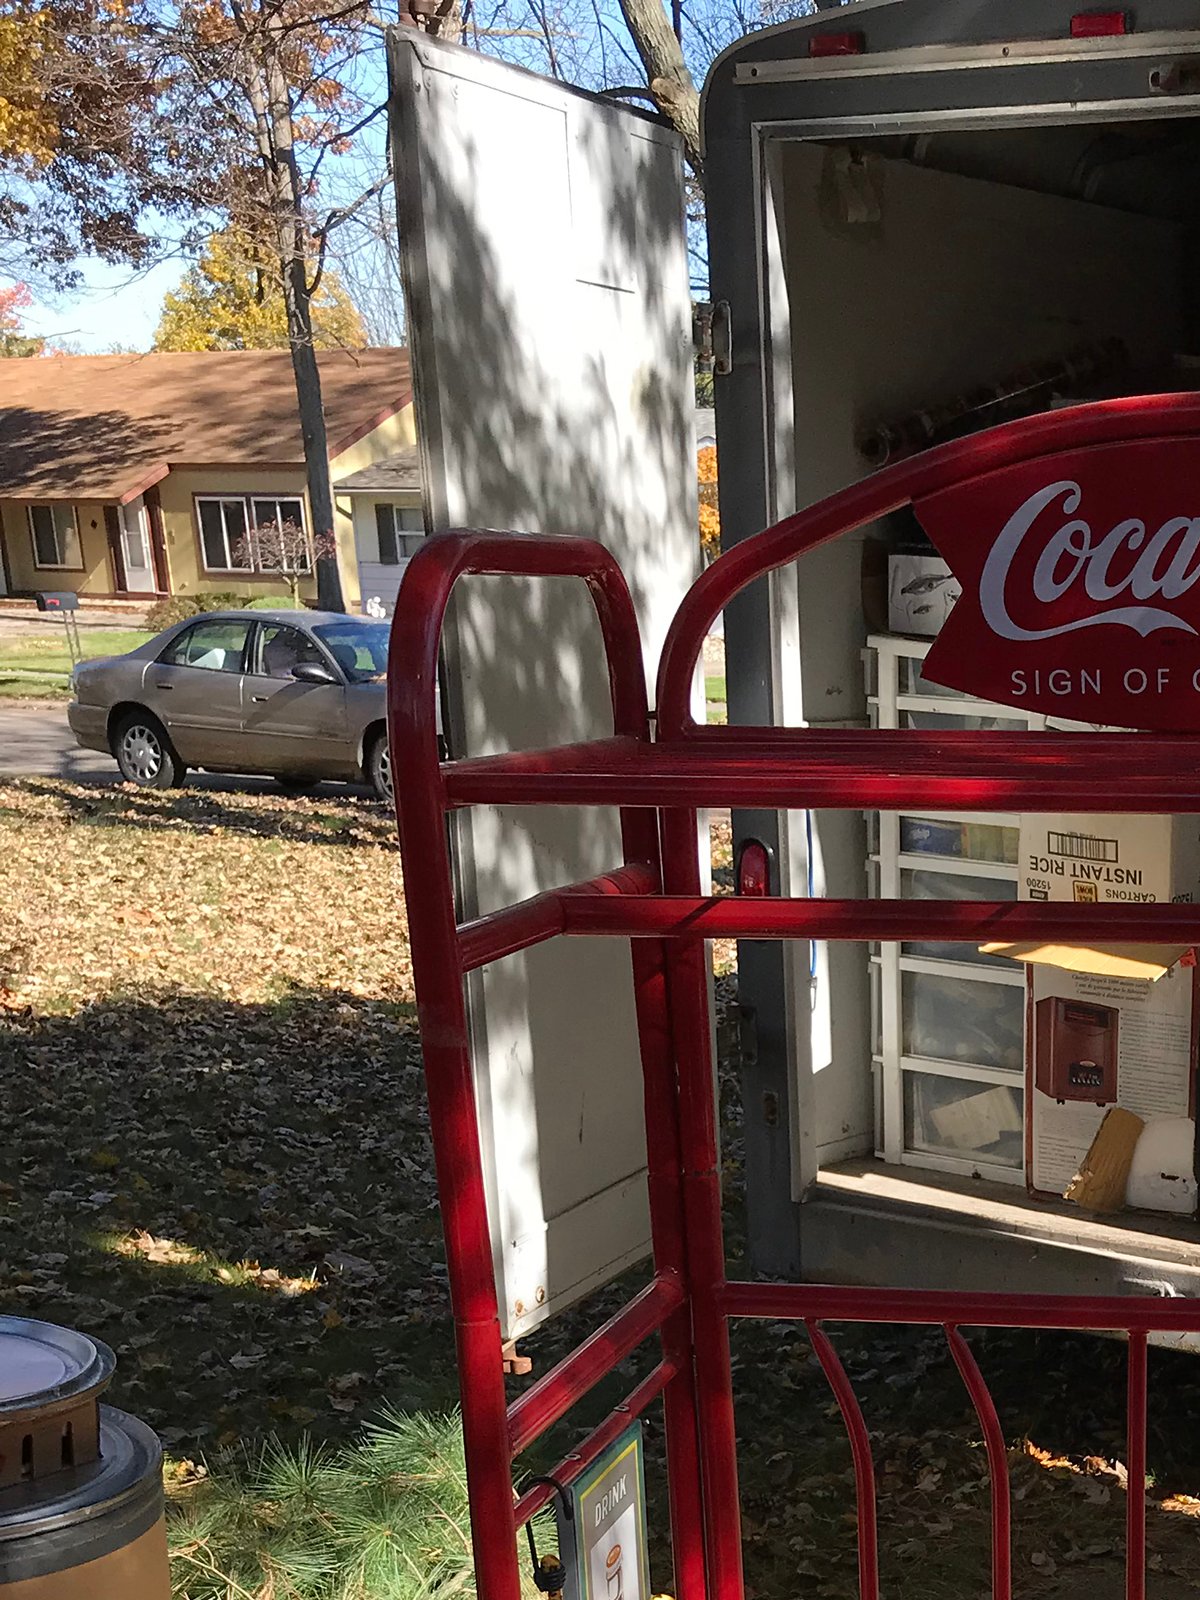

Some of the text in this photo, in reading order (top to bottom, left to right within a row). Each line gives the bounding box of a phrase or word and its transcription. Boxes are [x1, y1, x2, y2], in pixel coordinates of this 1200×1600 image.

[1011, 668, 1100, 697] SIGN
[1124, 668, 1171, 695] OF
[1026, 877, 1052, 891] 15200
[1029, 855, 1142, 886] INSTANT RICE
[1105, 888, 1157, 903] CARTONS
[595, 1473, 627, 1527] DRINK
